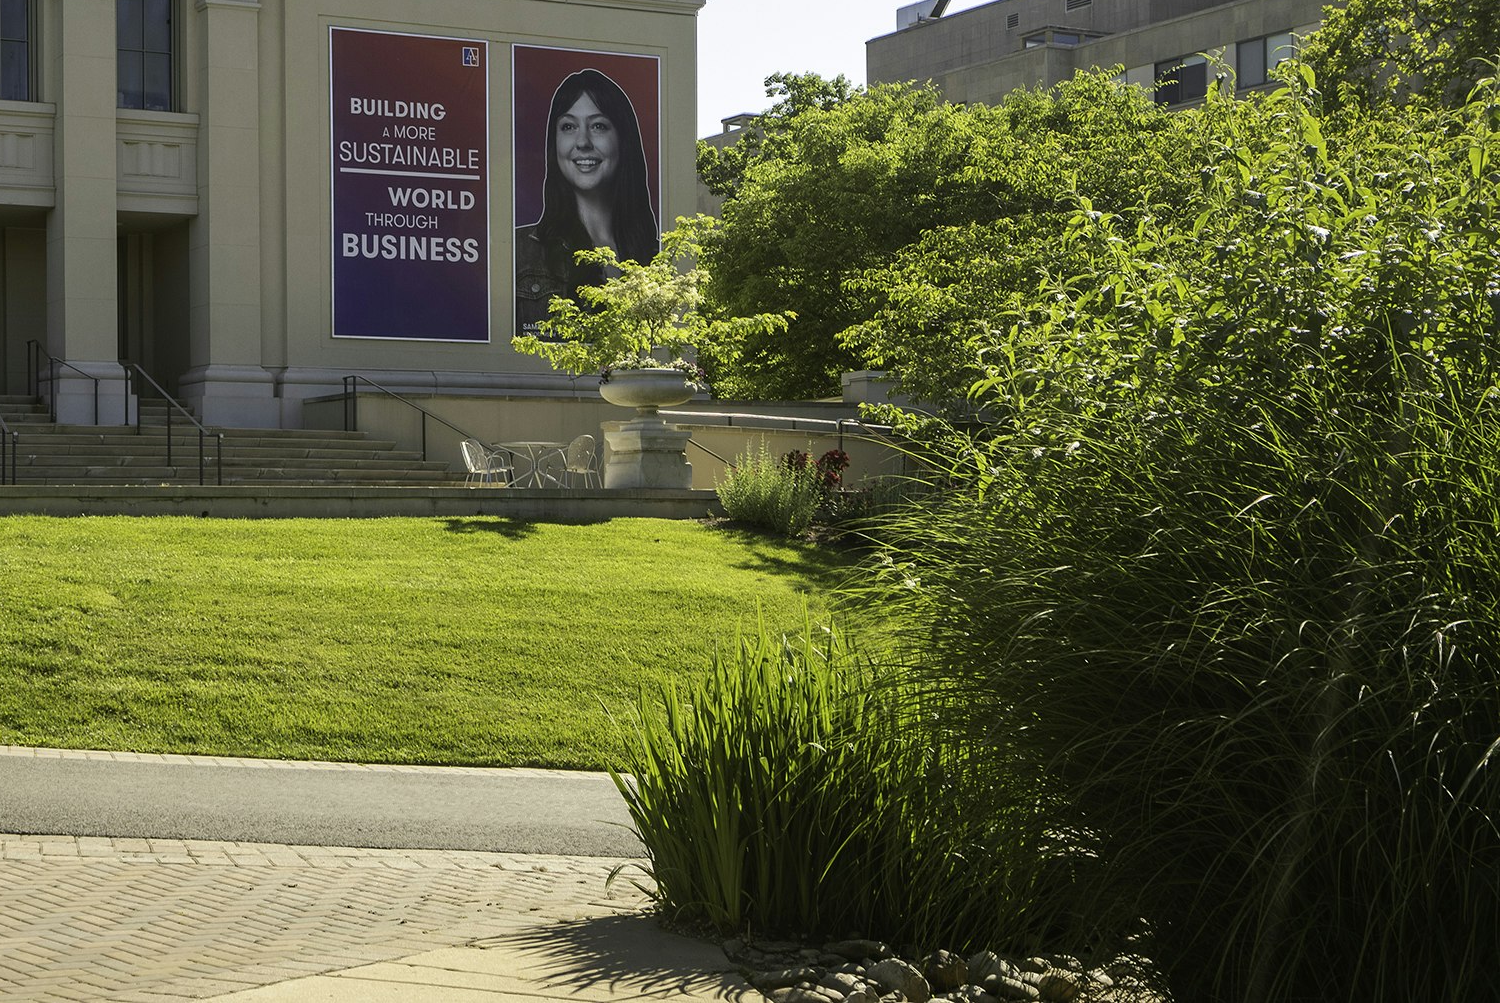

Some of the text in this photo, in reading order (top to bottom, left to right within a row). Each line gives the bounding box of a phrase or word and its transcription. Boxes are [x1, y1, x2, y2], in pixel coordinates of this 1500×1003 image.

[350, 97, 446, 121] BUILDING
[382, 125, 436, 141] A MORE
[339, 141, 479, 169] SUSTAINABLE
[388, 187, 475, 210] WORLD
[365, 212, 438, 229] THROUGH
[342, 233, 479, 263] BUSINESS
